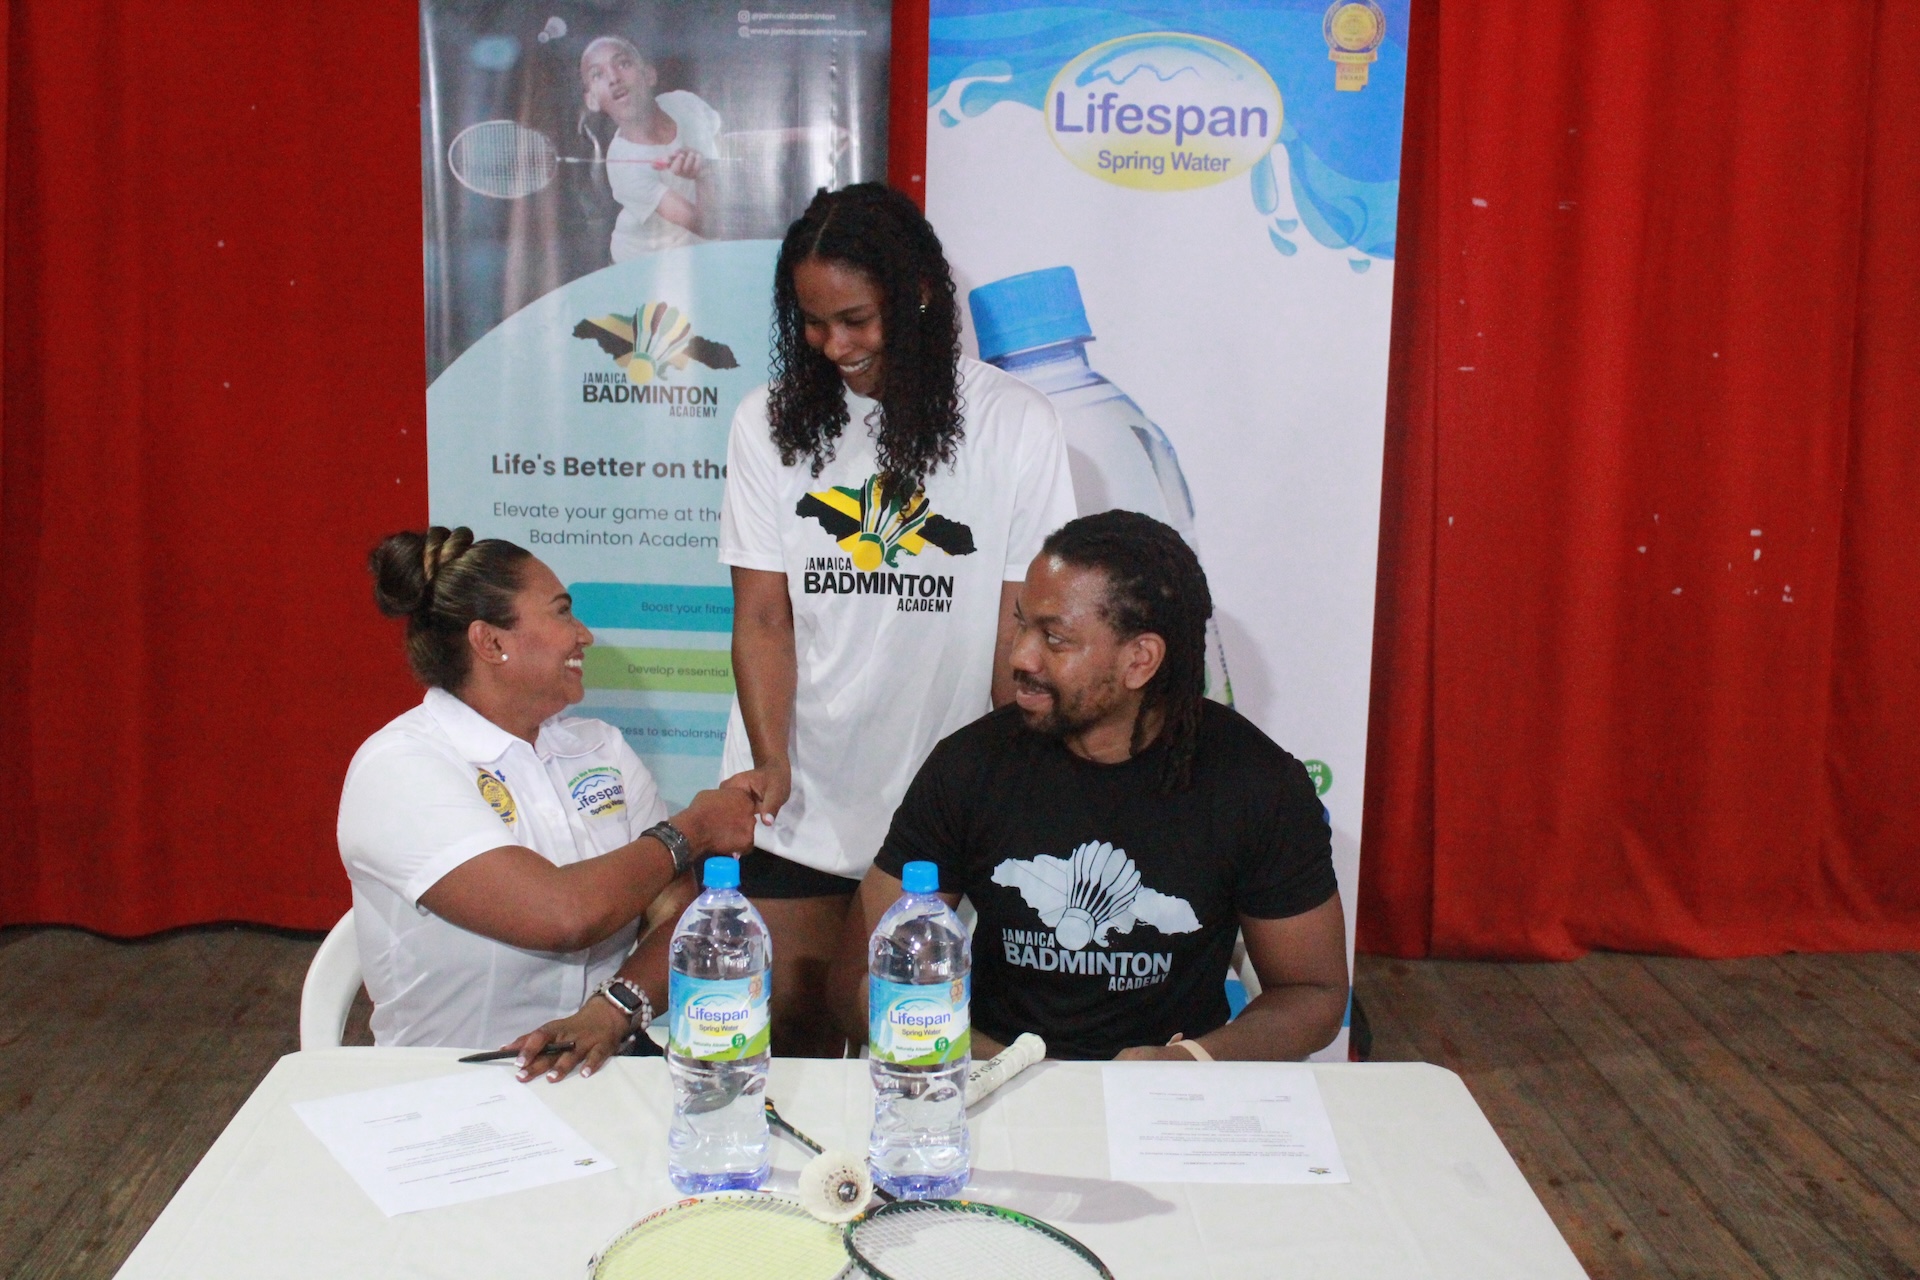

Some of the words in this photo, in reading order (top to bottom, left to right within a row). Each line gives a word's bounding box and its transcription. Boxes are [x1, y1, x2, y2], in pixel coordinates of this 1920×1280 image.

[1055, 91, 1268, 146] Lifespan
[1097, 150, 1165, 175] Spring
[1171, 151, 1231, 172] Water
[583, 372, 628, 384] JAMAICA
[583, 385, 718, 405] BADMINTON
[669, 406, 718, 418] ACADEMY
[492, 453, 556, 475] Life's
[563, 456, 646, 478] Better
[652, 462, 686, 479] on
[493, 502, 560, 519] Elevate
[564, 506, 607, 523] your
[612, 506, 669, 524] game
[674, 507, 693, 522] at
[699, 507, 722, 523] th
[529, 529, 633, 546] Badminton
[639, 531, 719, 549] Academ
[805, 557, 852, 571] JAMAICA
[804, 572, 954, 598] BADMINTON
[641, 601, 674, 612] Boost
[676, 604, 702, 615] your
[897, 598, 953, 613] ACADEMY
[627, 664, 675, 677] Develop
[677, 665, 729, 677] essential
[647, 727, 659, 736] to
[577, 784, 625, 811] ifespan
[1002, 928, 1056, 948] JAMAICA
[1003, 941, 1173, 976] BADMINTON
[1108, 972, 1169, 991] ACADEMY
[687, 1005, 749, 1024] Lifespan
[890, 1010, 951, 1027] Lifespan
[699, 1024, 720, 1033] Spring
[721, 1024, 739, 1032] Water
[901, 1028, 923, 1037] Spring
[924, 1028, 942, 1036] Water
